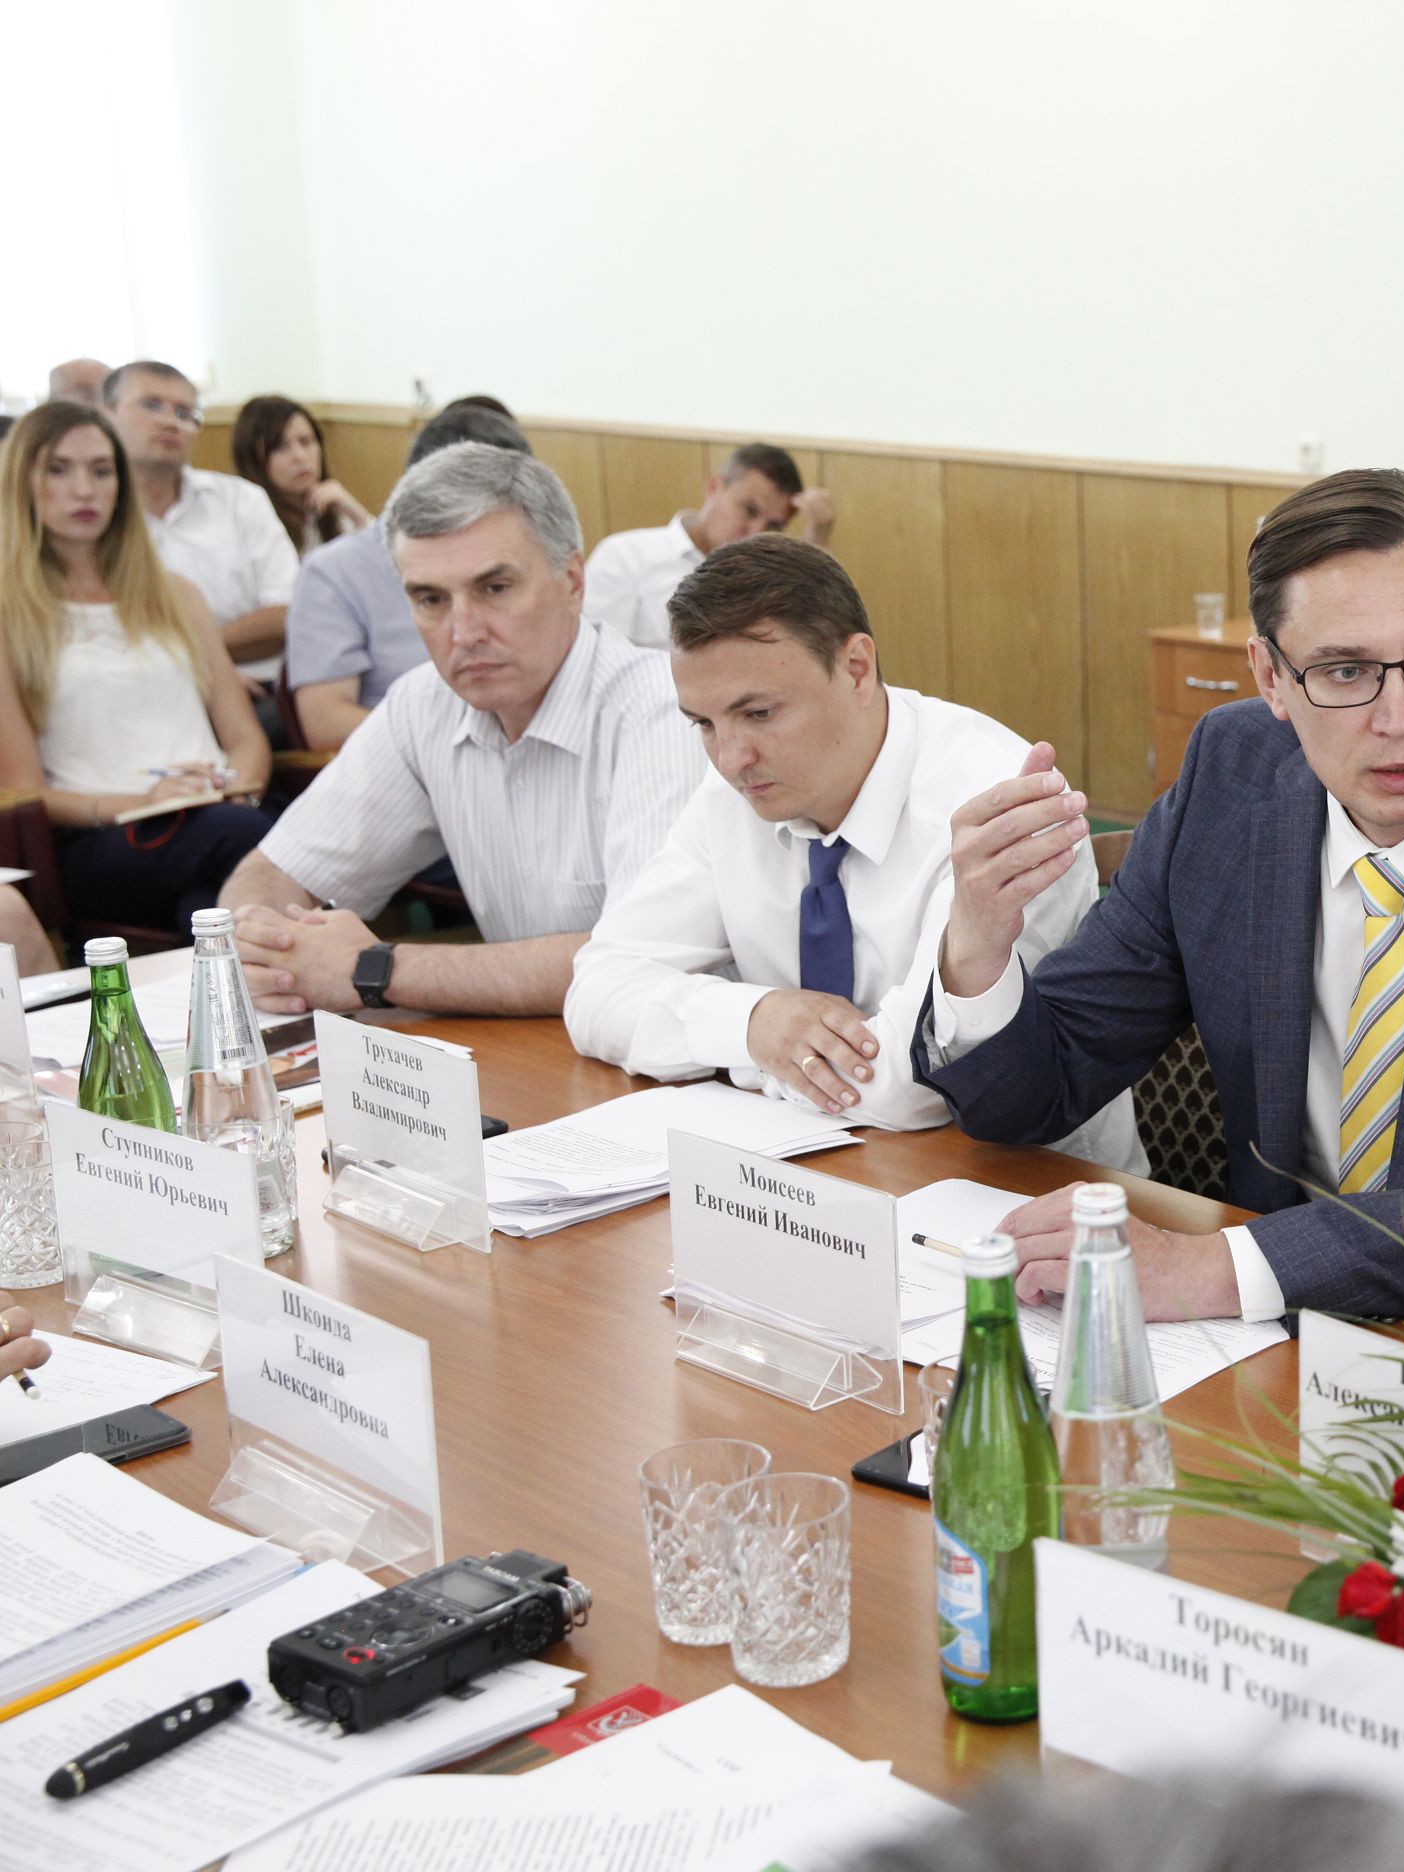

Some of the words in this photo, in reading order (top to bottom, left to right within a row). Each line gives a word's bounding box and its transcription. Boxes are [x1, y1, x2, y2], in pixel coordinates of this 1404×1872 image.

[362, 1035, 423, 1072] Трухачев
[362, 1066, 430, 1109] Александр
[351, 1090, 447, 1141] Владимирович
[101, 1127, 194, 1171] Ступников
[75, 1152, 144, 1191] Евгений
[148, 1173, 229, 1216] Юрьевич
[738, 1163, 816, 1207] Моисеев
[694, 1184, 769, 1227] Евгений
[774, 1209, 867, 1260] Иванович
[282, 1289, 352, 1342] Шконда
[294, 1333, 346, 1378] Елена
[260, 1357, 389, 1439] Александровна
[1070, 1615, 1209, 1685] Аркадий
[1170, 1593, 1309, 1667] Торосян
